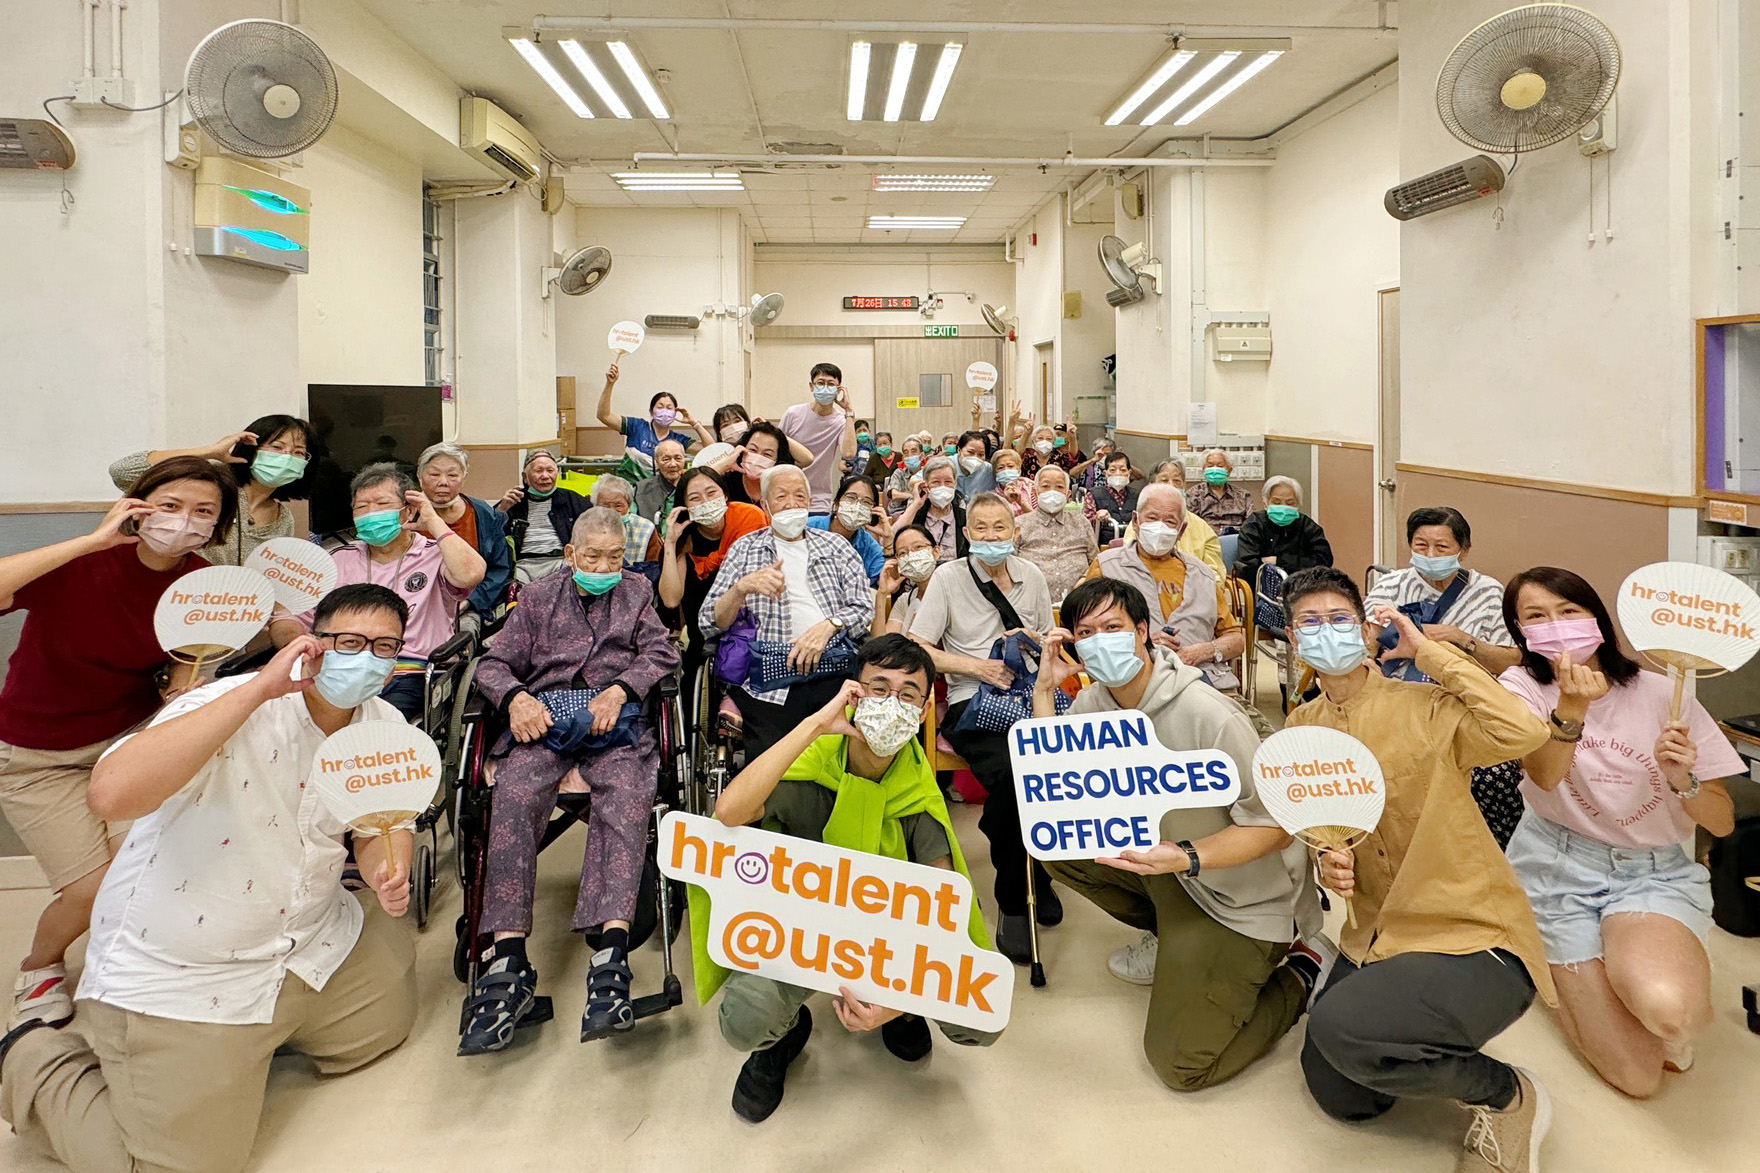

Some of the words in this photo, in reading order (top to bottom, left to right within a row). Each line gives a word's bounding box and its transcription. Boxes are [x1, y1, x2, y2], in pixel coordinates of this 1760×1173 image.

[263, 567, 323, 599] @ust.hk
[184, 609, 264, 625] @ust.hk
[1651, 608, 1756, 639] @ust.hk
[1016, 717, 1149, 756] HUMAN
[345, 764, 433, 793] @ust.hk
[1023, 760, 1231, 803] RESOURCES
[1610, 738, 1634, 757] big
[1636, 753, 1662, 793] things
[1287, 777, 1377, 803] @ust.hk
[1030, 816, 1152, 851] OFFICE
[722, 911, 999, 1014] @ust.hk
